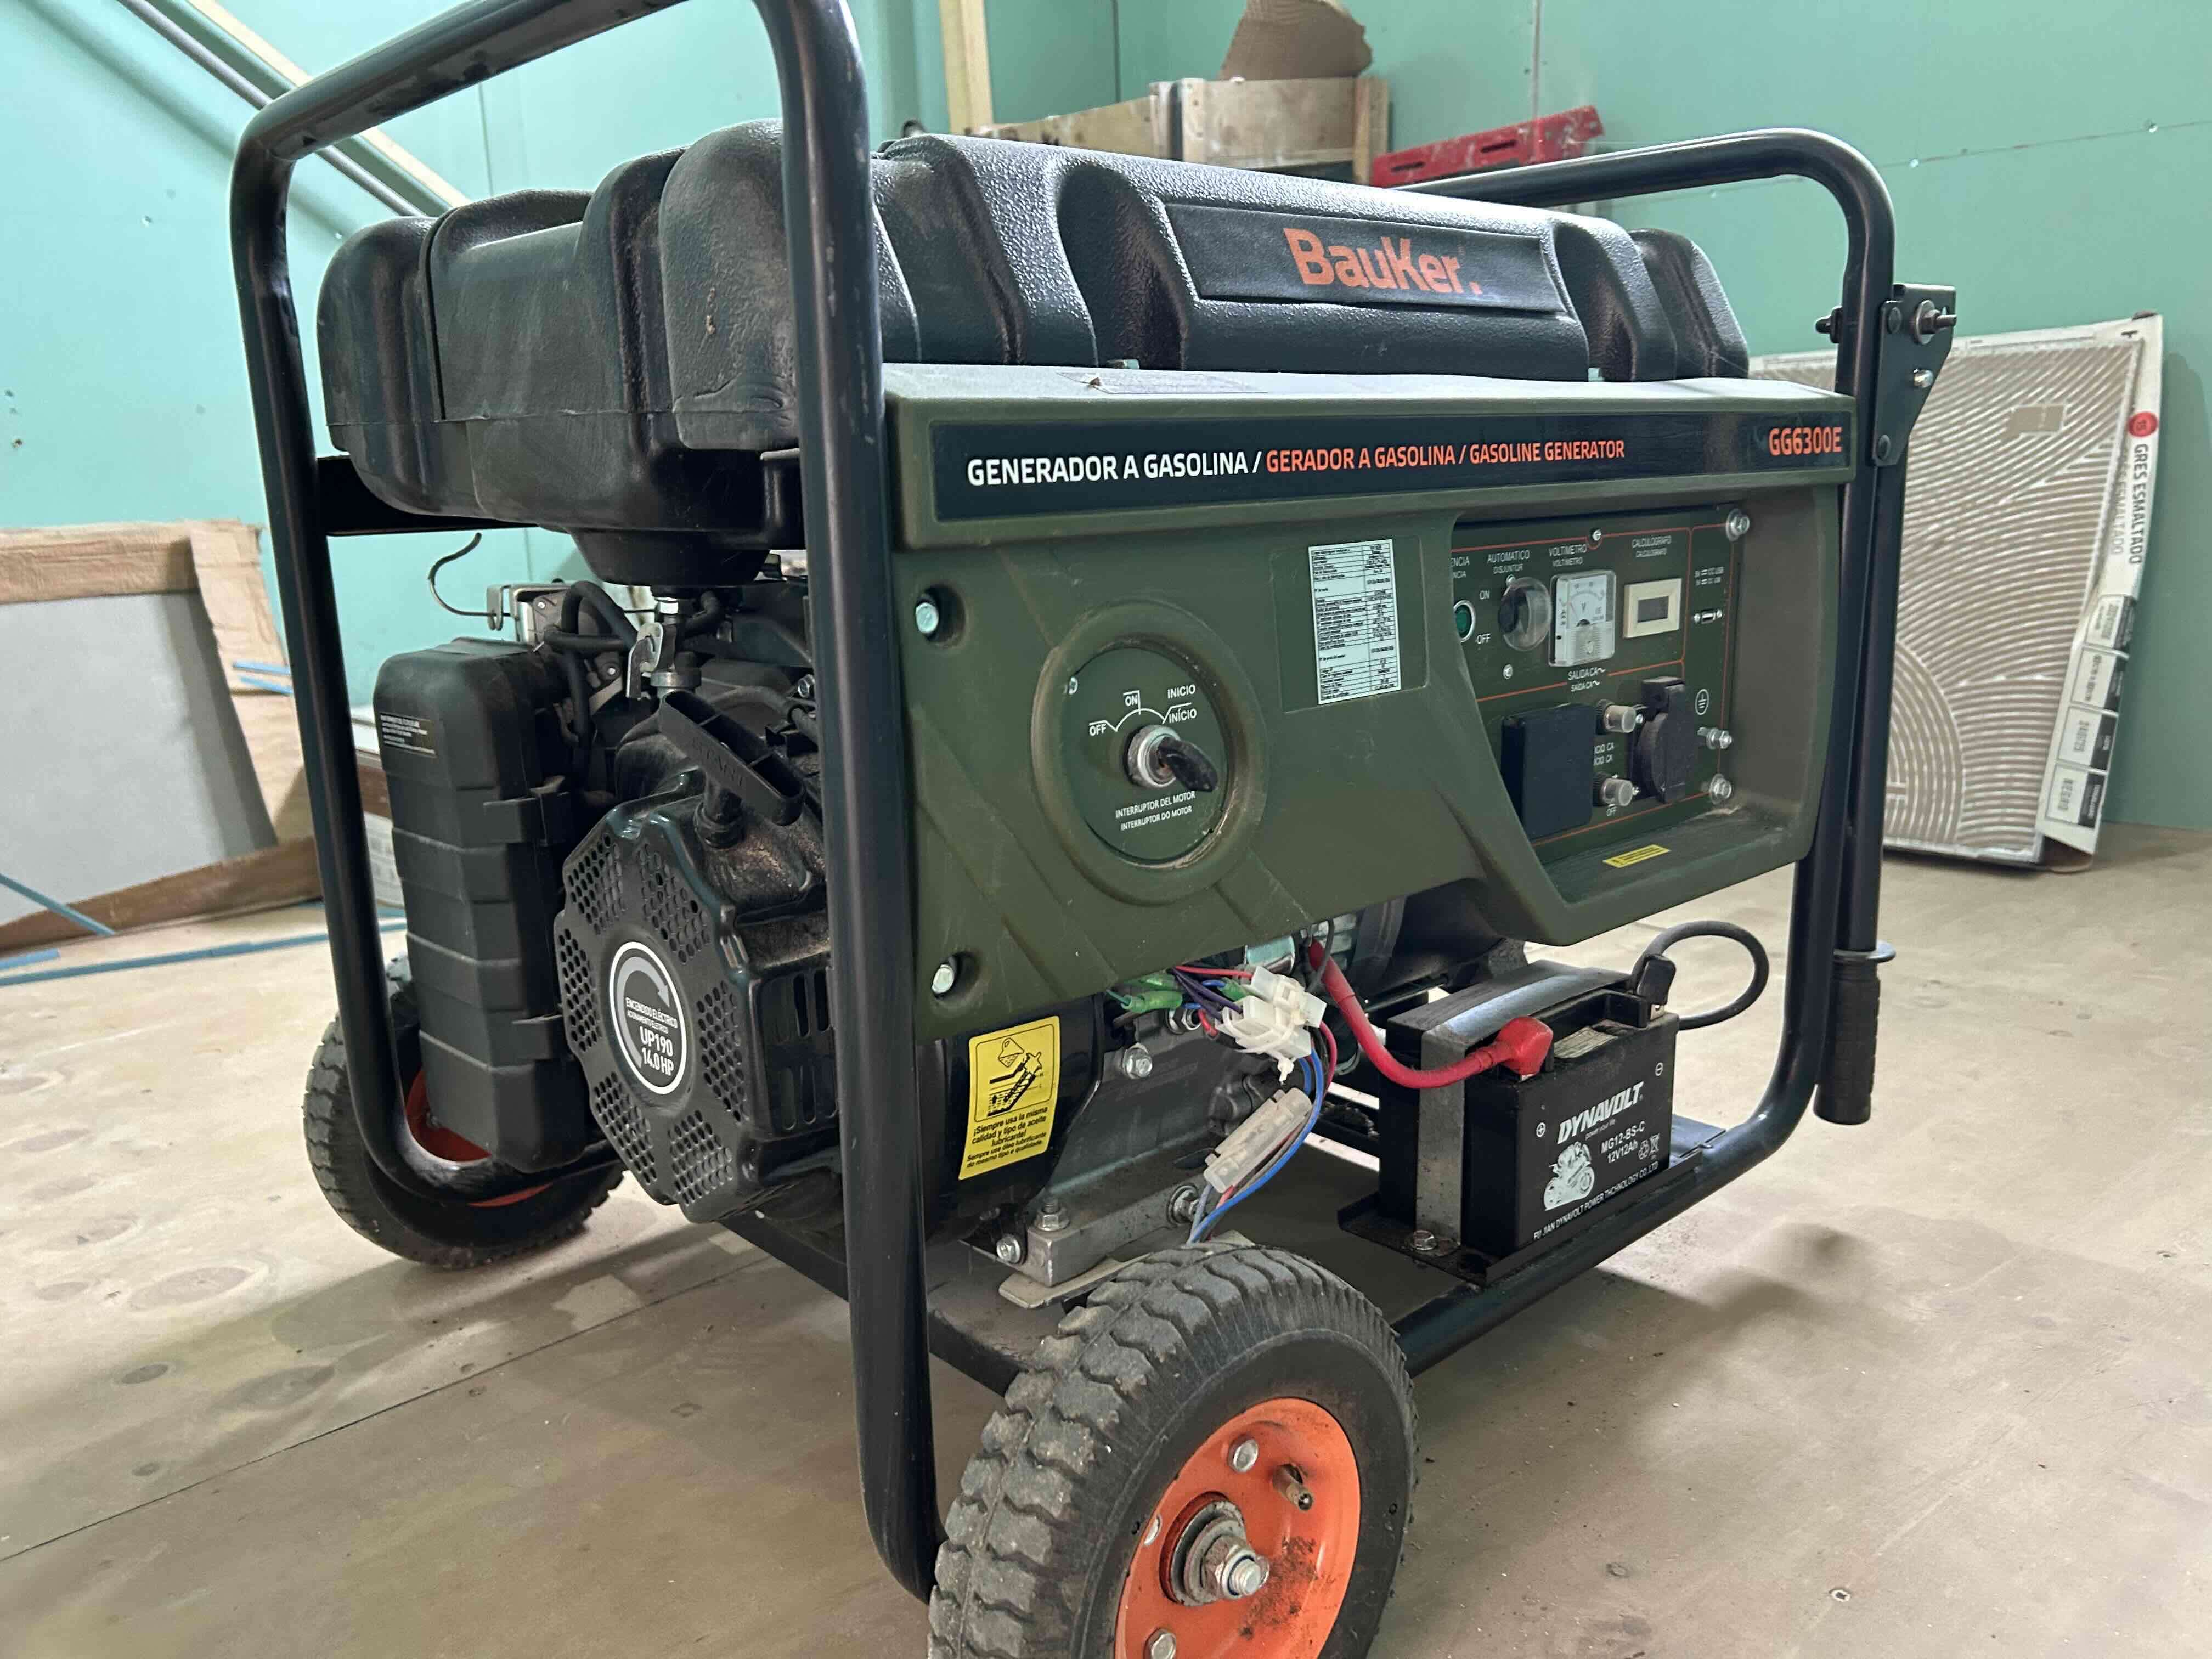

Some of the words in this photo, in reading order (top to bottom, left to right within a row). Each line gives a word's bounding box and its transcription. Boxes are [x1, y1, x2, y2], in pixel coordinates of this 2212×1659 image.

[1769, 426, 1842, 456] GG6300E
[967, 455, 1119, 486] GENERADOR
[1123, 455, 1140, 479] A
[1143, 451, 1249, 479] GASOLINA
[1266, 447, 1355, 473] GERADOR
[1358, 447, 1372, 469] A
[1374, 445, 1456, 469] GASOLINA
[1470, 442, 1542, 464] GASOLINE
[1544, 439, 1624, 461] GENERATOR
[2133, 443, 2149, 480] GRES
[2128, 483, 2147, 565] ESMALTADO
[1479, 590, 1490, 600] ON
[1475, 633, 1492, 645] OFF
[1125, 695, 1138, 707] ON
[1167, 684, 1196, 699] INICIO
[1169, 707, 1197, 723] INÍCIO
[1089, 723, 1107, 736] OFF
[1115, 800, 1159, 819] INTERRUPTOR
[1160, 797, 1172, 807] DEL
[1172, 791, 1195, 804] MOTOR
[1120, 814, 1161, 831] INTERRUPTOR
[1161, 811, 1171, 820] DO
[1171, 805, 1192, 817] MOTOR
[640, 1026, 673, 1057] UP190
[641, 1047, 660, 1071] 14.0
[660, 1056, 674, 1076] HP
[1026, 1107, 1048, 1119] misma
[1556, 1080, 1644, 1145] DYNAVOLT
[972, 1131, 997, 1144] calidad
[1003, 1126, 1017, 1135] tipo
[1026, 1116, 1047, 1126] aceite
[1600, 1120, 1646, 1154] MG12-BS-C
[967, 1150, 989, 1161] Sempre
[998, 1150, 1009, 1159] tipo
[1607, 1139, 1638, 1164] 12V12Ah
[1555, 1205, 1584, 1228] DYNAVOLT
[1584, 1192, 1605, 1210] POWER
